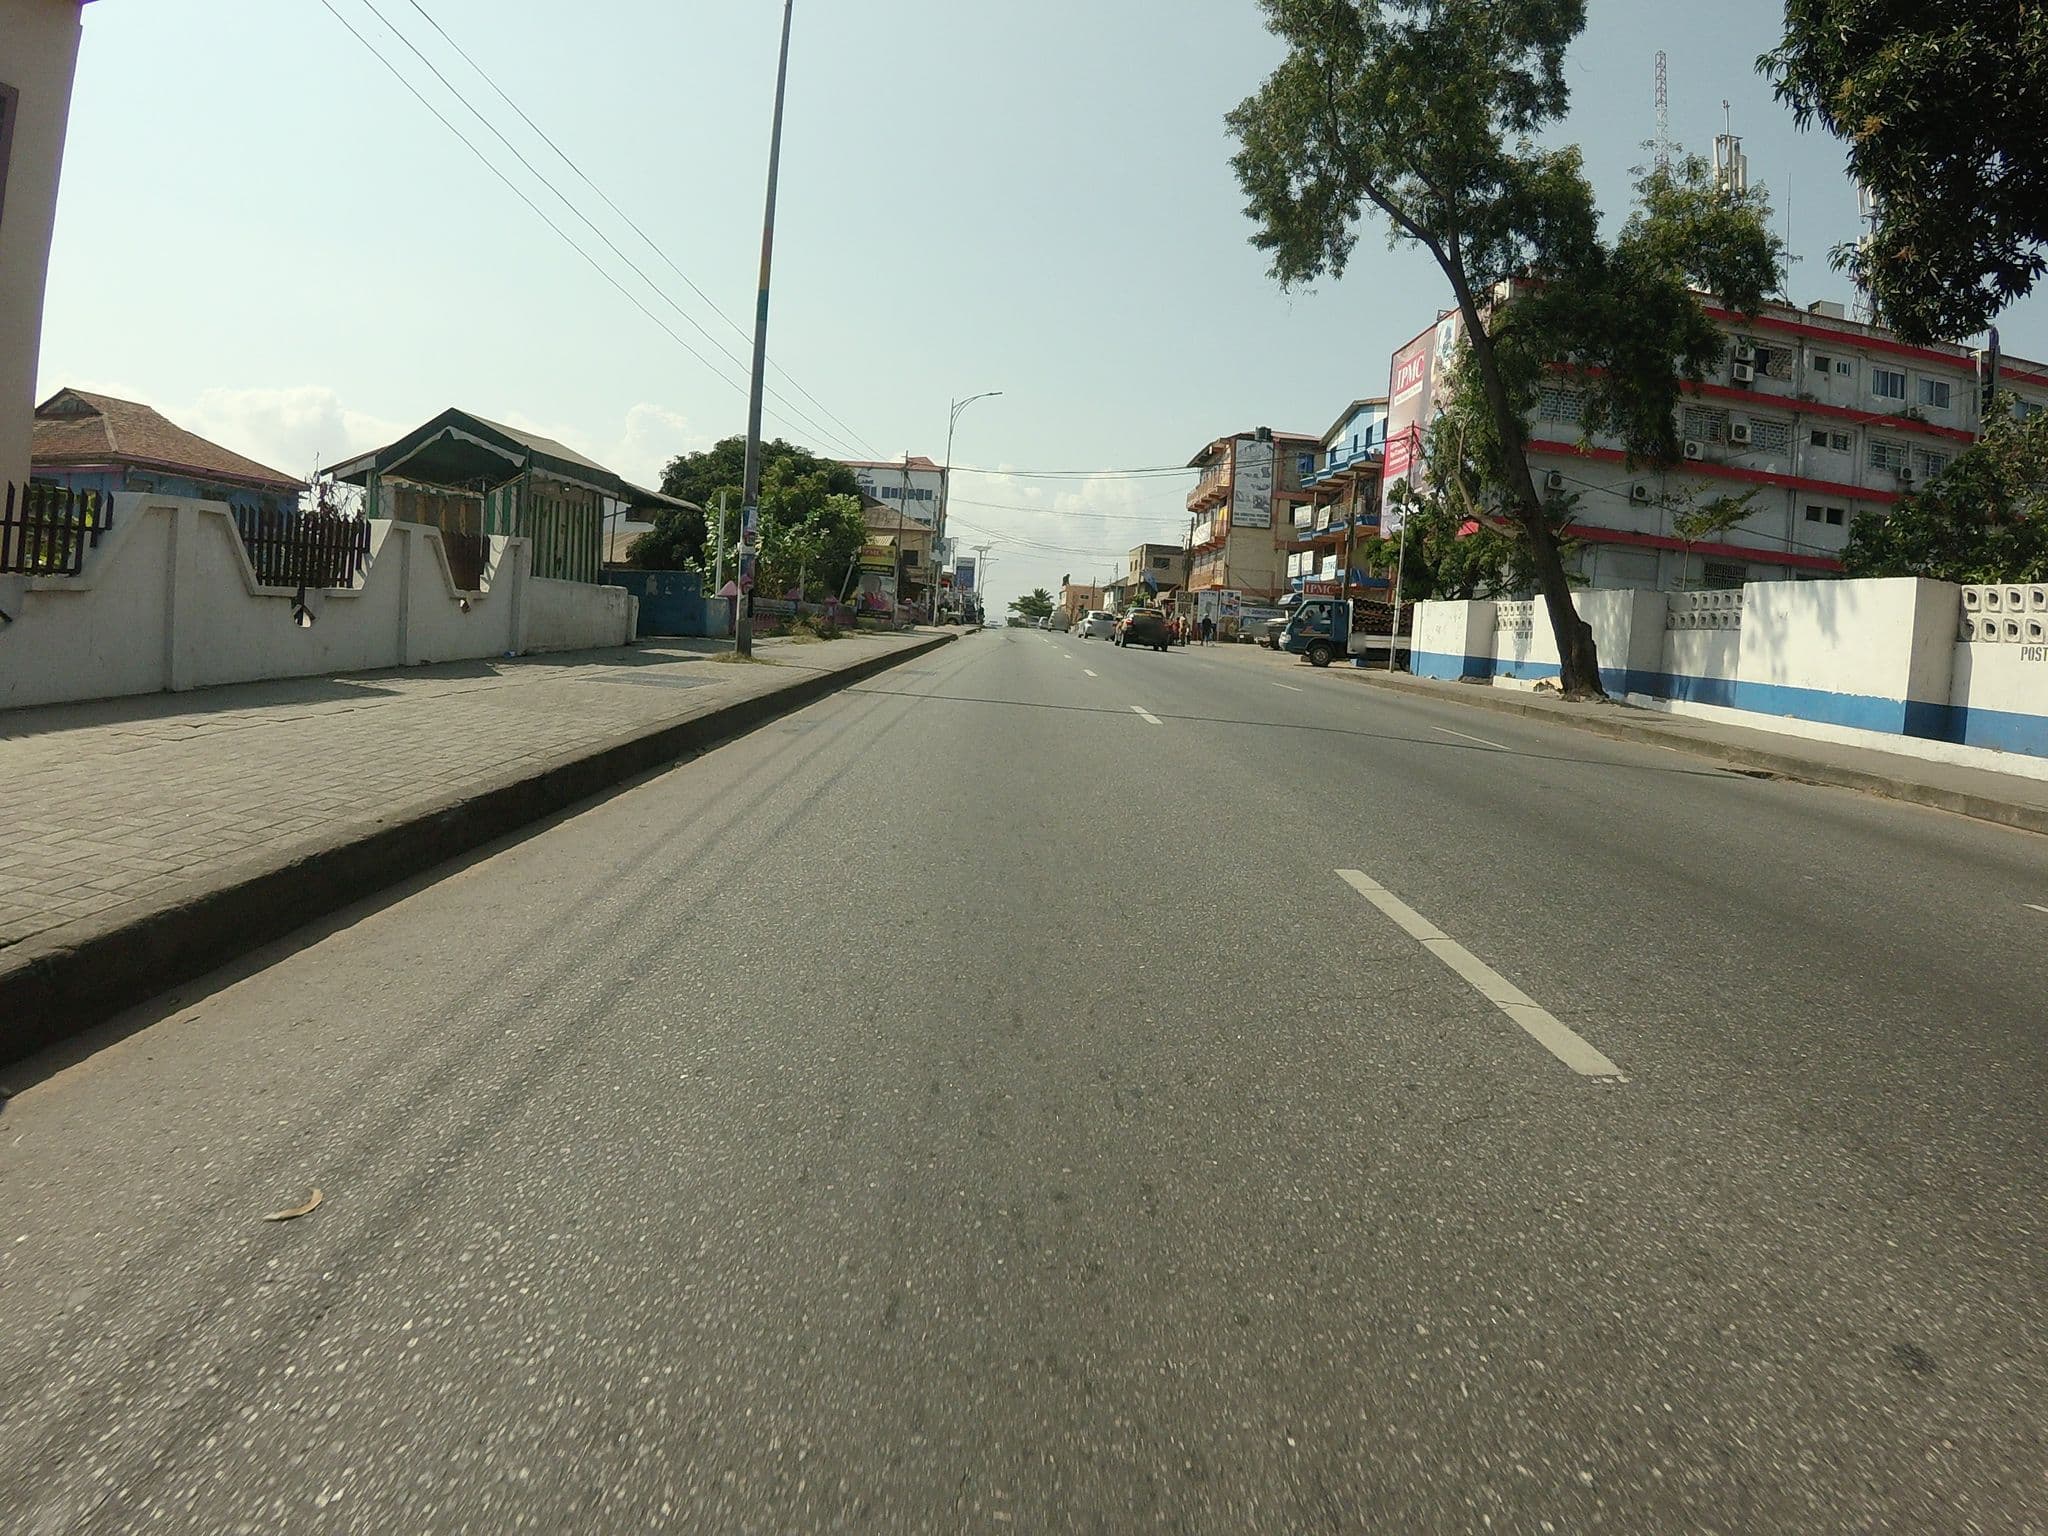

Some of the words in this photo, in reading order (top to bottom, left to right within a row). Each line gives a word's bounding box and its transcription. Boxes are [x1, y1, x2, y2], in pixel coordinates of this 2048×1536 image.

[1396, 354, 1424, 391] IPMC
[1305, 583, 1335, 595] IPMC
[2020, 646, 2048, 662] POST
